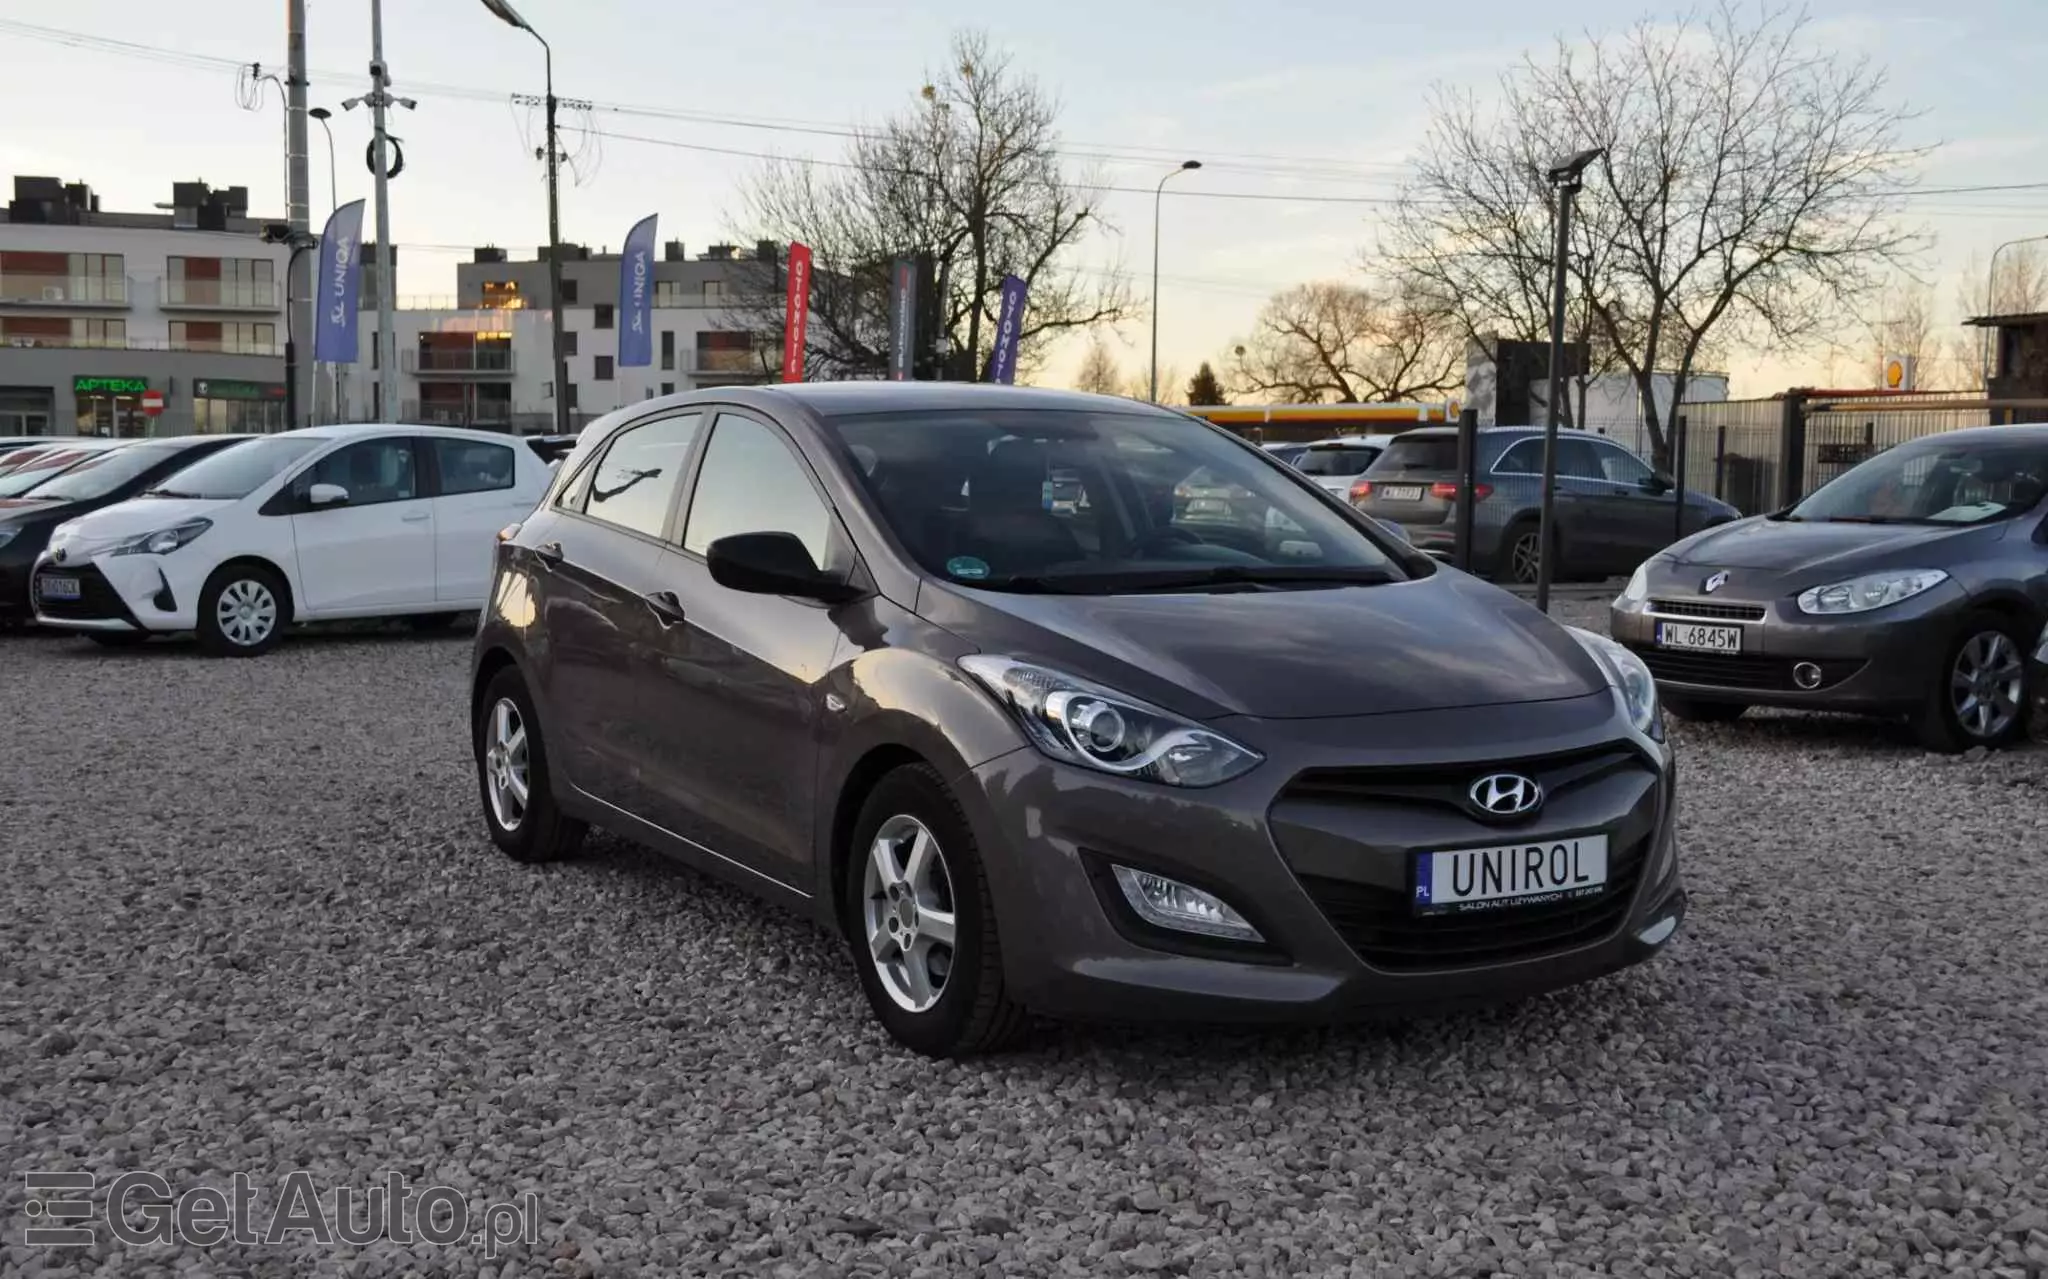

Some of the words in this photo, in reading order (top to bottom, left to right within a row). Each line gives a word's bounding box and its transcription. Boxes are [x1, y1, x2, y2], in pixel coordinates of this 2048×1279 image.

[334, 236, 350, 297] UNIQA
[75, 378, 146, 392] APTEKA
[1665, 625, 1682, 645] WL
[1688, 627, 1738, 649] 6845W
[1453, 841, 1589, 897] UNIROL
[1416, 885, 1431, 898] PL
